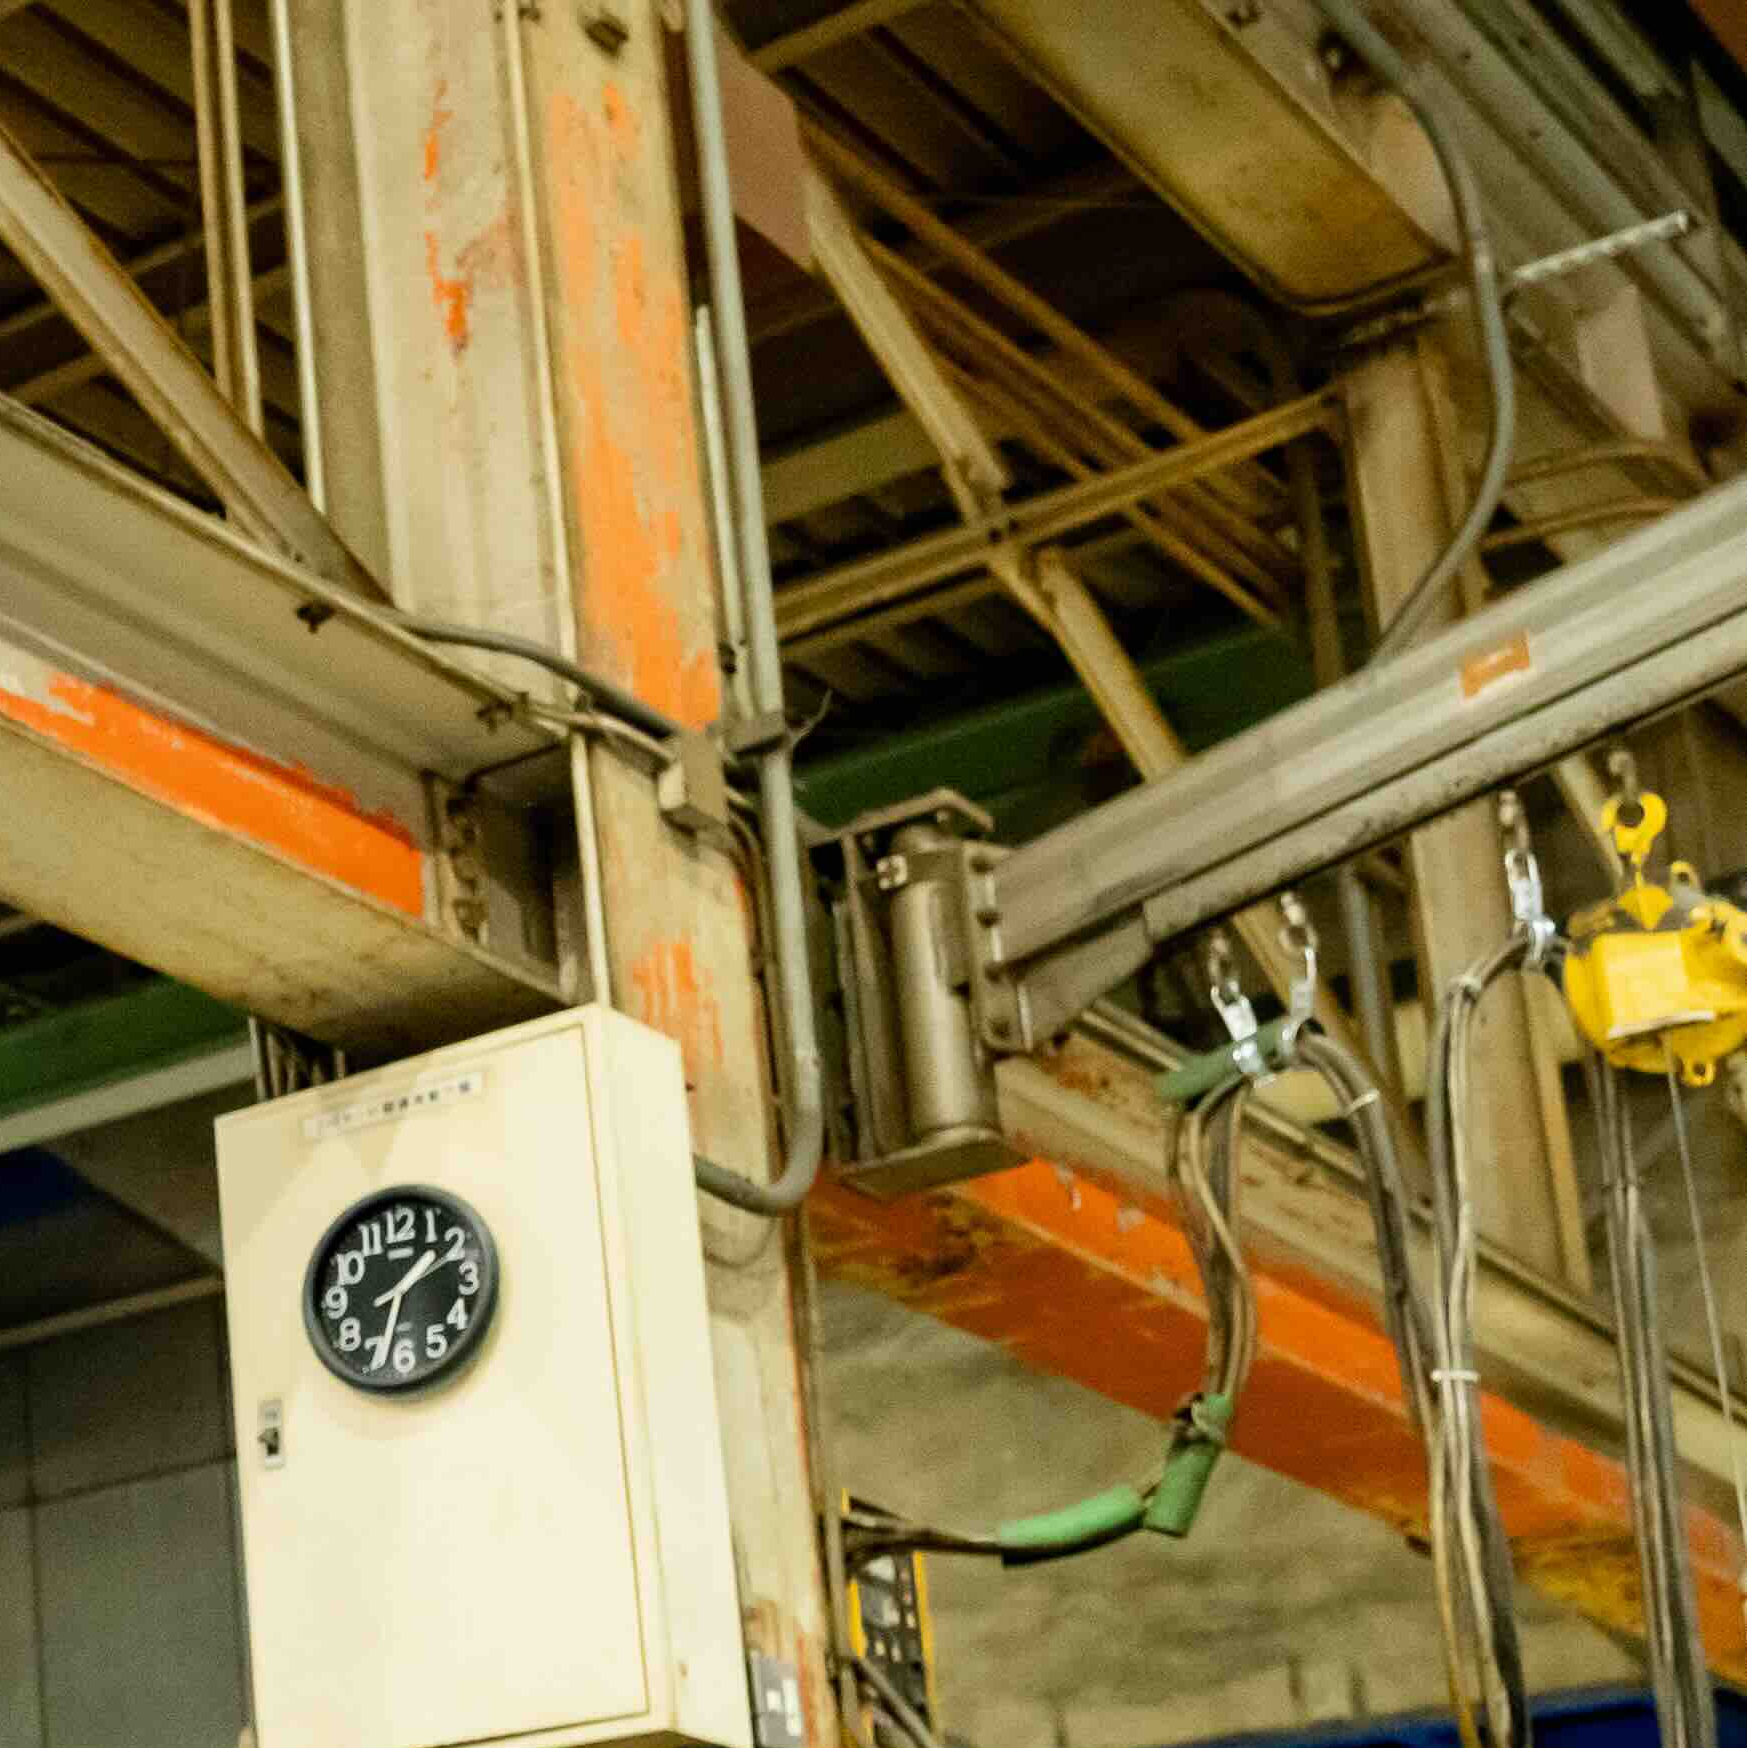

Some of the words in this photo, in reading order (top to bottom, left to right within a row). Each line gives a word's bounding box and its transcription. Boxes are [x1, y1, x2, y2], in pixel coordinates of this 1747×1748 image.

[358, 1222, 383, 1257] 11
[384, 1206, 415, 1244] 12
[424, 1208, 438, 1244] 1
[444, 1226, 466, 1262] 2
[336, 1250, 366, 1286] 10
[458, 1260, 479, 1295] 3
[325, 1285, 348, 1320] 9
[446, 1297, 468, 1331] 4
[339, 1317, 362, 1352] 8
[425, 1323, 448, 1359] 5
[364, 1335, 387, 1371] 7
[393, 1338, 416, 1374] 6
